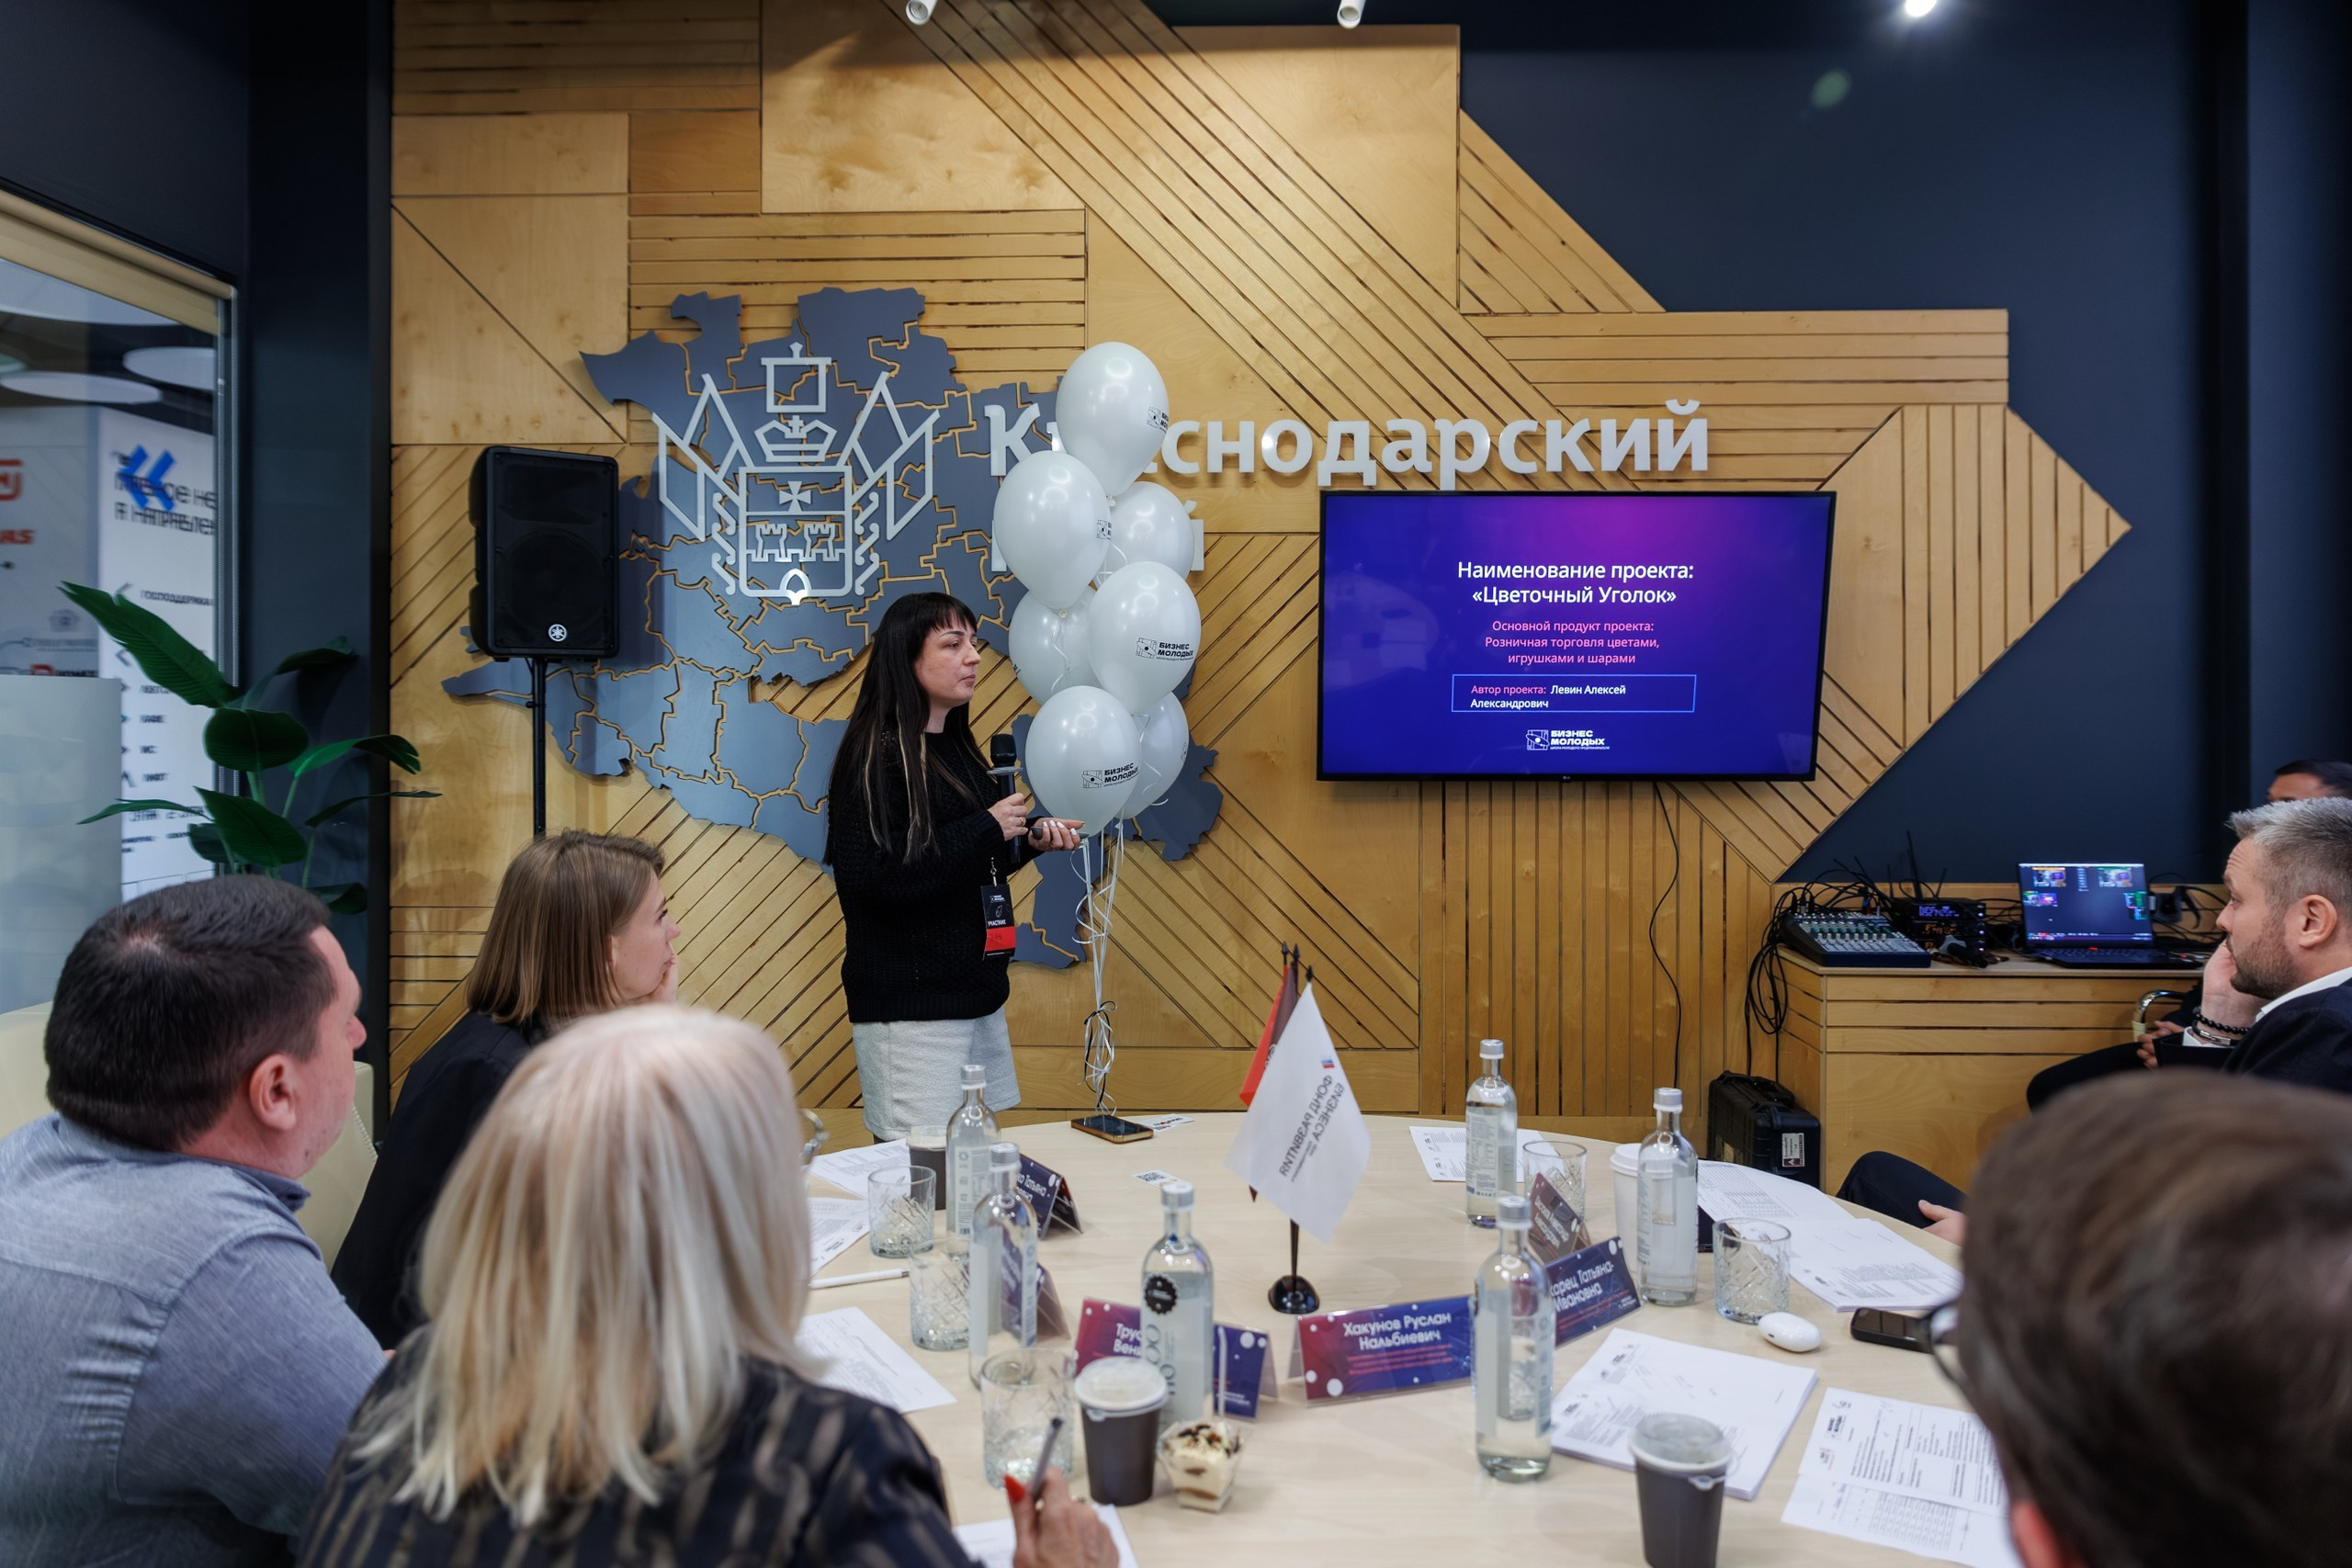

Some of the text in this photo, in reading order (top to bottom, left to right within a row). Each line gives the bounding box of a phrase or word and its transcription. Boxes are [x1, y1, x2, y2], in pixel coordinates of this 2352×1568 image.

[984, 399, 1709, 490] Кснодарский
[1458, 561, 1694, 583] Наименование проекта:
[1472, 586, 1677, 606] «Цветочный Уголок»
[1492, 620, 1655, 634] Основной продукт проекта:
[1159, 642, 1190, 650] БИЗНЕС
[1485, 637, 1660, 649] Розничная торговля цветами,
[1158, 649, 1193, 658] МОЛОДЫХ
[1508, 654, 1636, 666] игрушками и шарами
[1471, 684, 1626, 696] Автор проекта: Левин Алексей
[1470, 698, 1549, 710] Александрович
[1104, 762, 1134, 776] БИЗНЕС
[1577, 1260, 1612, 1282] Татьяна
[1554, 1282, 1602, 1313] Ивановна
[1342, 1313, 1452, 1338] Хакунов Руслан
[1359, 1330, 1442, 1351] Нальбиевич
